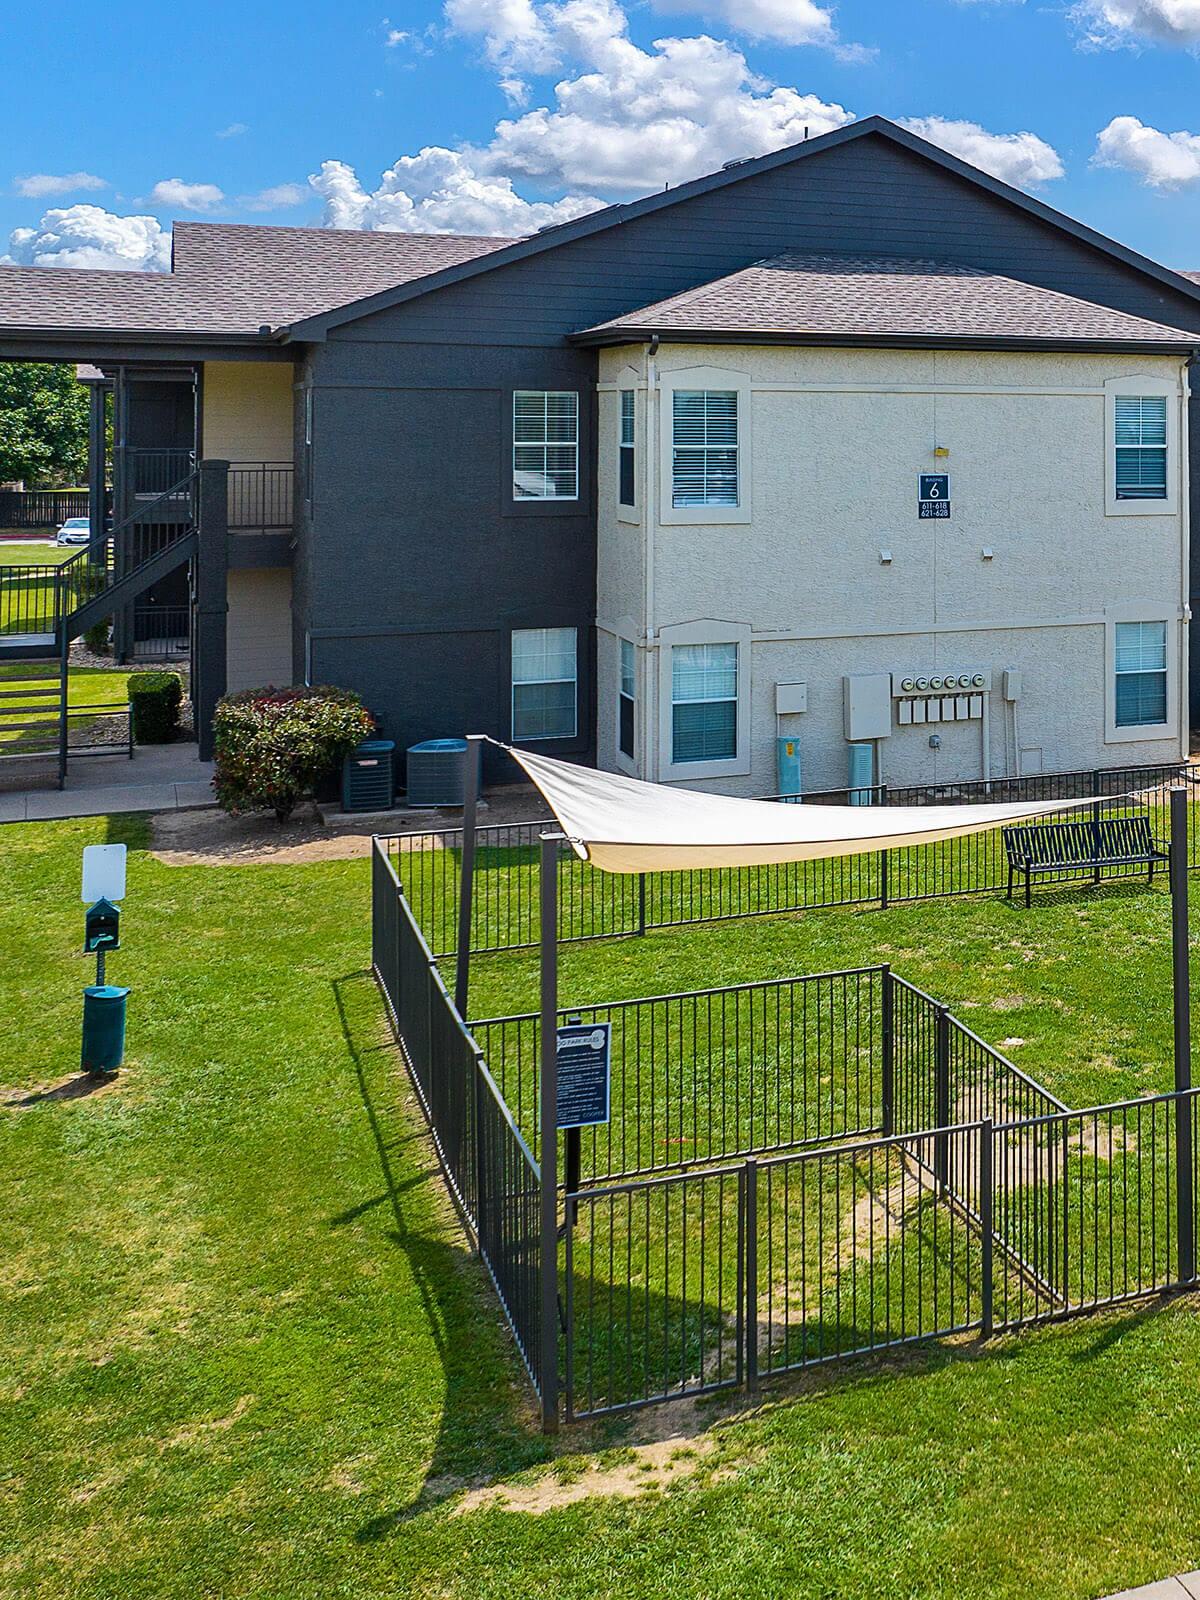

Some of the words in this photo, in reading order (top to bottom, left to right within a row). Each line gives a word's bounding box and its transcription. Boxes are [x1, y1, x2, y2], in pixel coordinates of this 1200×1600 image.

[930, 482, 939, 498] 6
[922, 502, 948, 510] 611-618
[921, 509, 948, 517] 621-628
